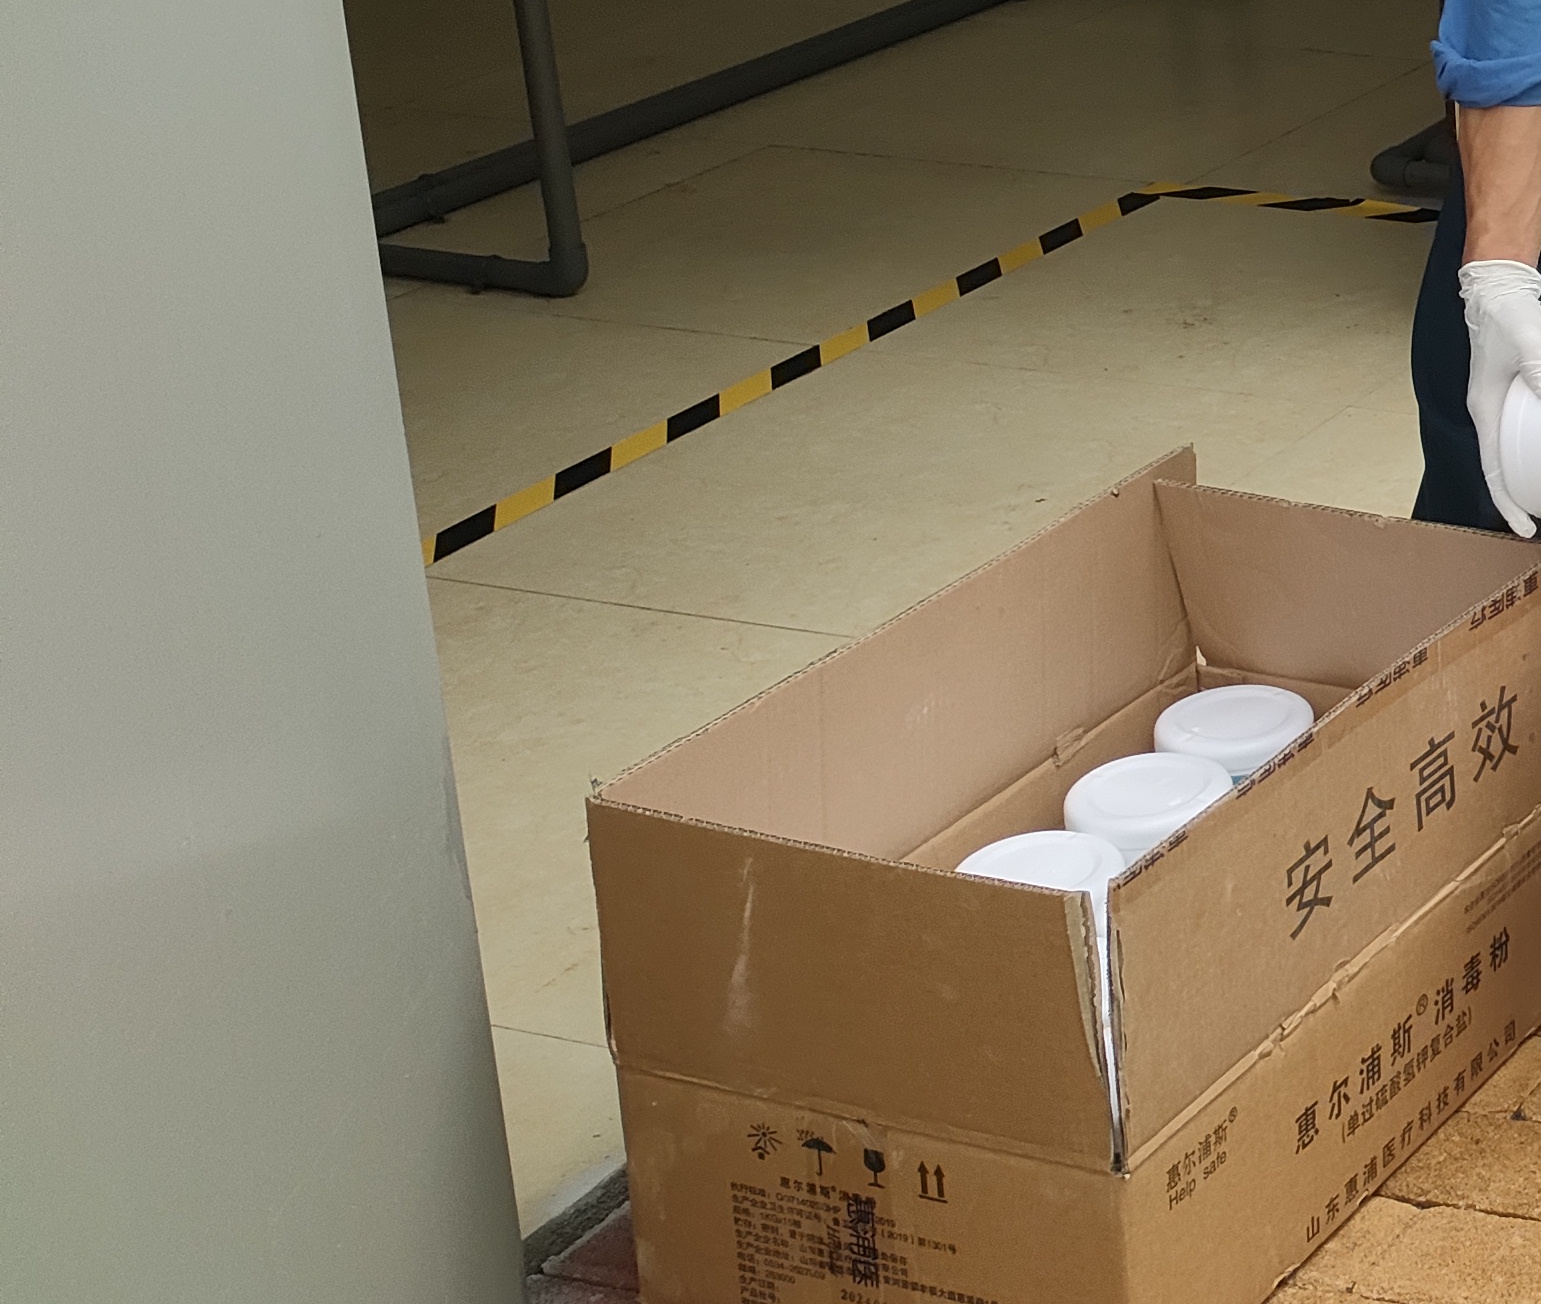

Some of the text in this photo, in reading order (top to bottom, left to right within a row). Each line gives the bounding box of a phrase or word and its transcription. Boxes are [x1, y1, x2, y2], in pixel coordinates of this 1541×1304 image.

[1285, 685, 1520, 940] 安全高效
[1167, 1149, 1228, 1211] Help safe
[1305, 1019, 1517, 1243] 山东惠浦医疗科技有限公司
